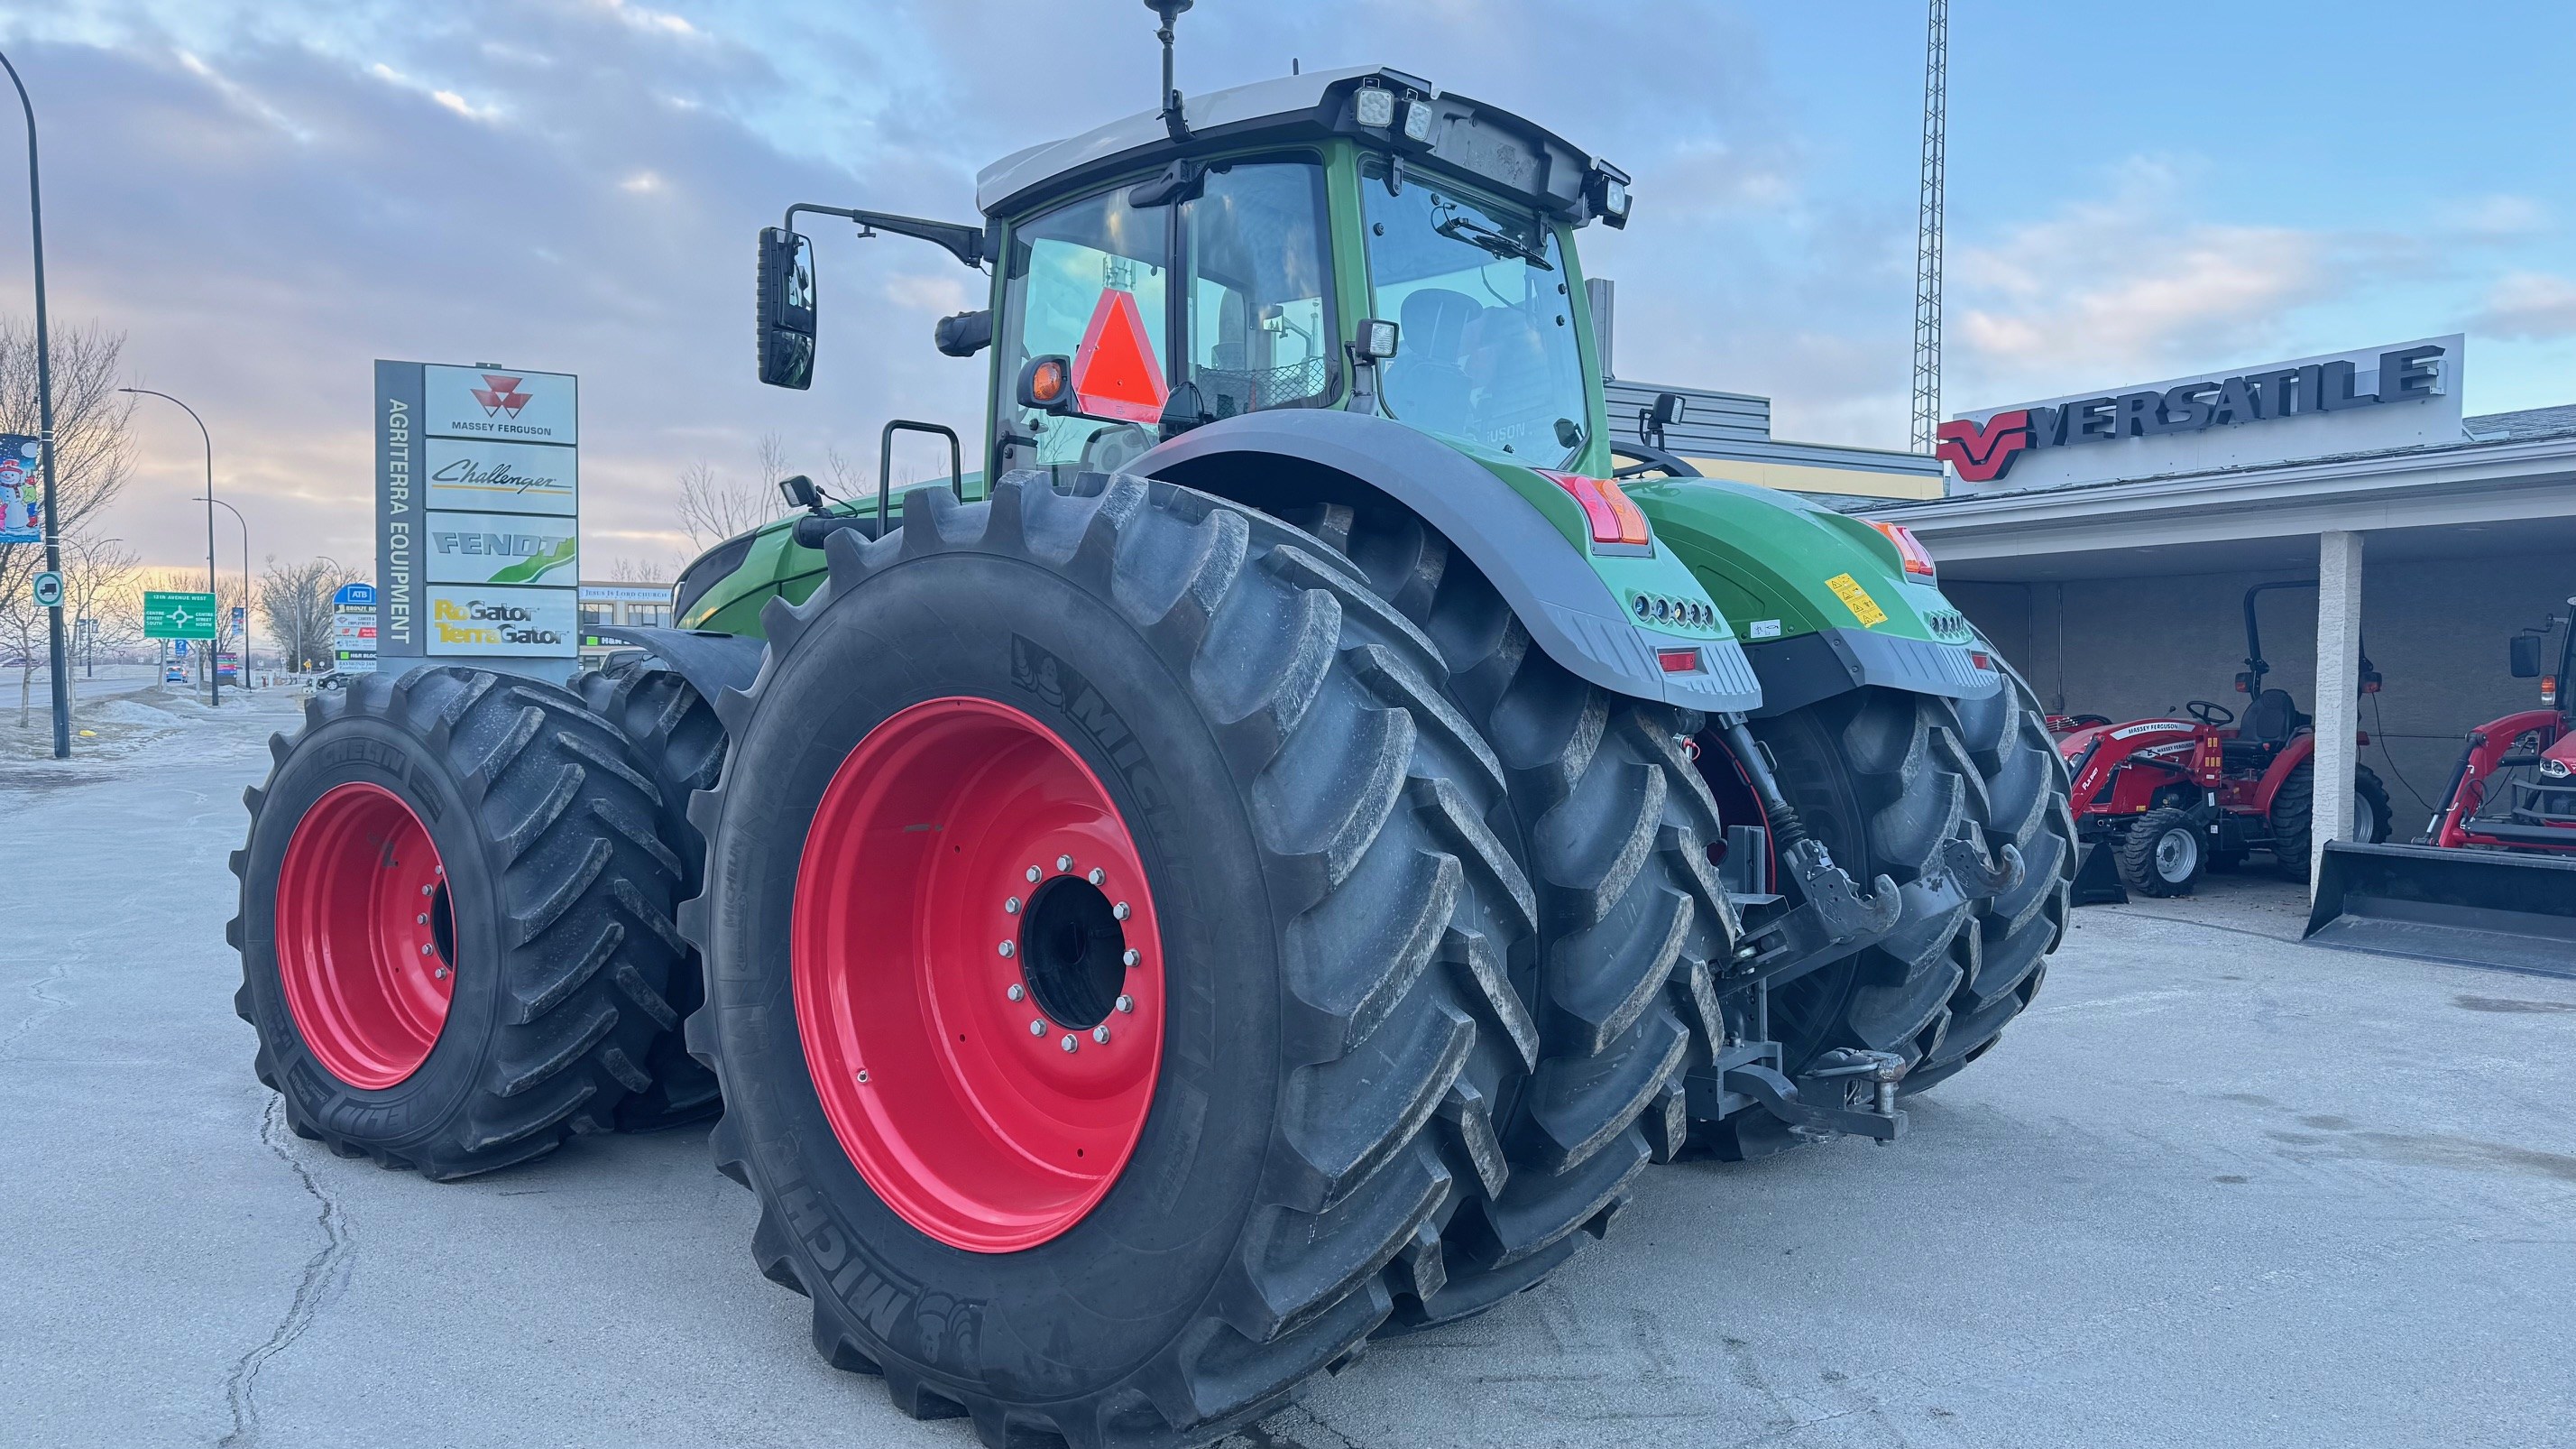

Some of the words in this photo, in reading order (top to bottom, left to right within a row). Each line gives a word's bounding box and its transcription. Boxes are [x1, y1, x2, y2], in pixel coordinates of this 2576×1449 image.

[2027, 345, 2445, 448] VERSATILE
[452, 421, 494, 432] MASSEY
[498, 424, 551, 436] FERGUSON
[389, 398, 409, 515] AGRITERRA
[431, 458, 573, 494] Challenger
[432, 531, 568, 558] FENDT
[390, 522, 409, 644] EQUIPMENT
[434, 598, 538, 622] RoGator
[434, 622, 568, 645] TerraGator
[2129, 725, 2149, 734] MASSEY
[310, 739, 408, 777] ICHELIN
